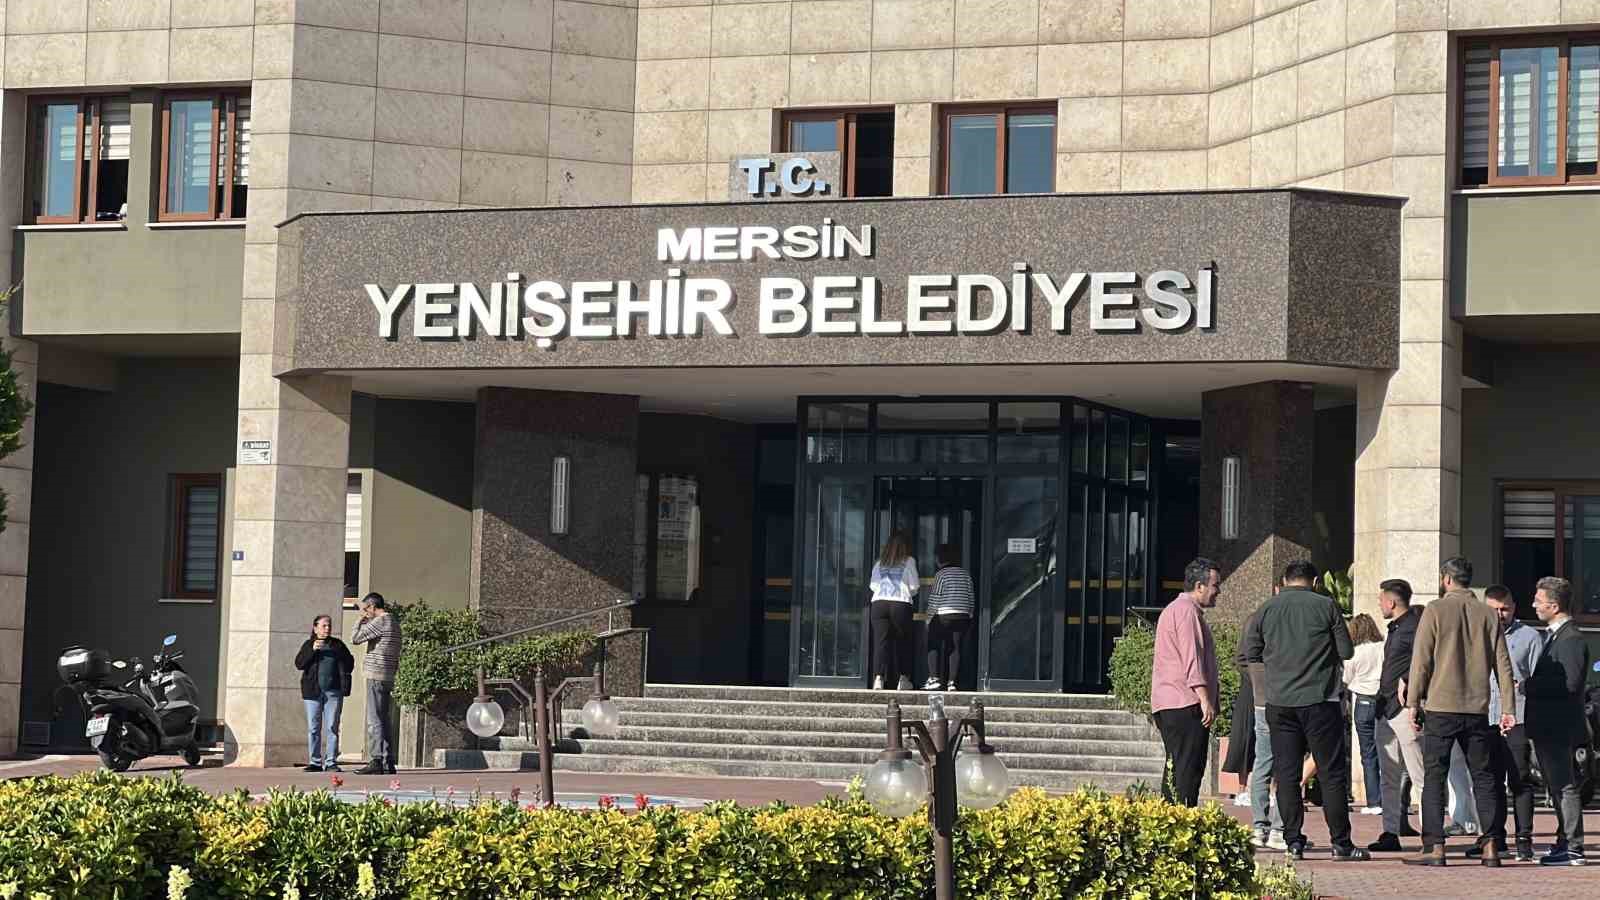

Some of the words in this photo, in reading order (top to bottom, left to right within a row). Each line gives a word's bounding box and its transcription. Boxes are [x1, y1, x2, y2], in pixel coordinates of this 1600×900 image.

[739, 158, 826, 194] T.C.
[657, 218, 872, 262] MERSİN
[363, 268, 735, 348] YENİŞEHİR
[758, 261, 1212, 334] BELEDİYESİ
